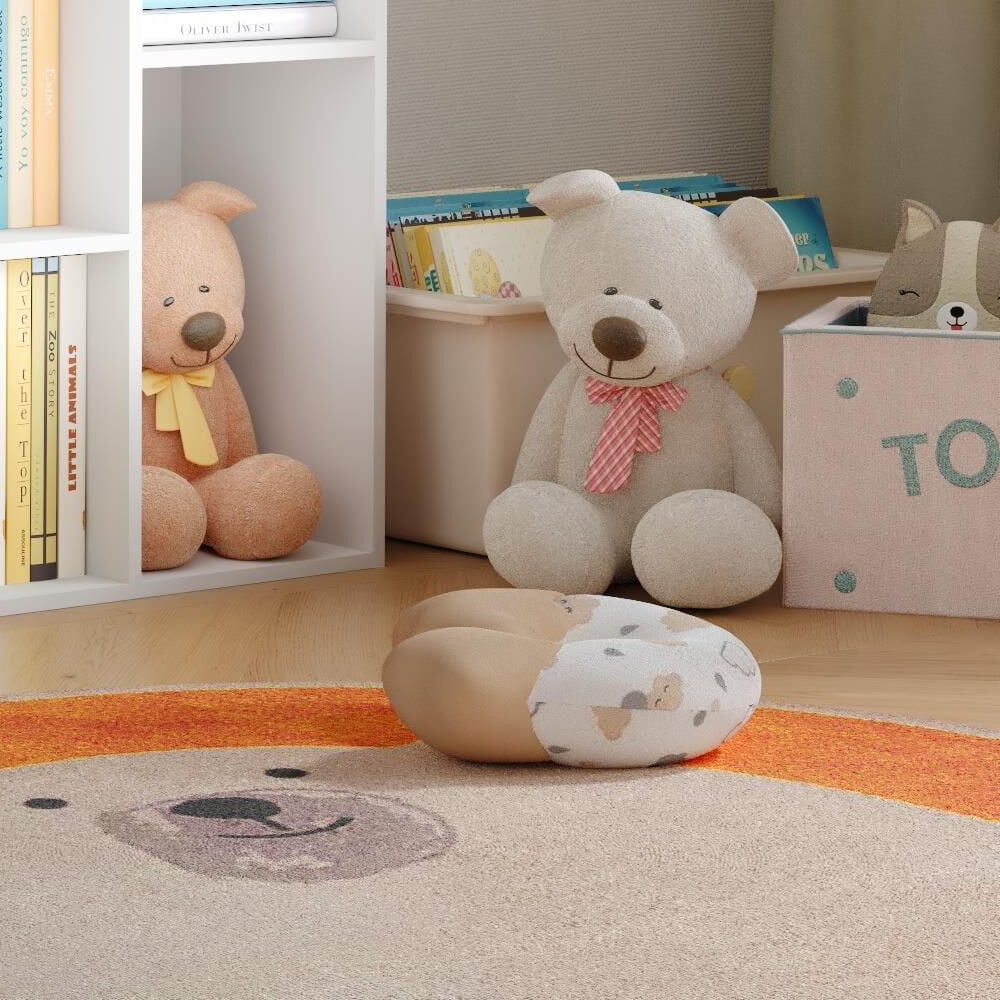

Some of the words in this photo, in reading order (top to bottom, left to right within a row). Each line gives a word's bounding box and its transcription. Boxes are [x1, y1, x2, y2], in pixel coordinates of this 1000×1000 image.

[18, 15, 30, 98] conmigo
[18, 106, 29, 138] voy
[18, 146, 28, 172] Yo
[68, 344, 77, 425] ANIMALS
[68, 428, 77, 491] LITTLE
